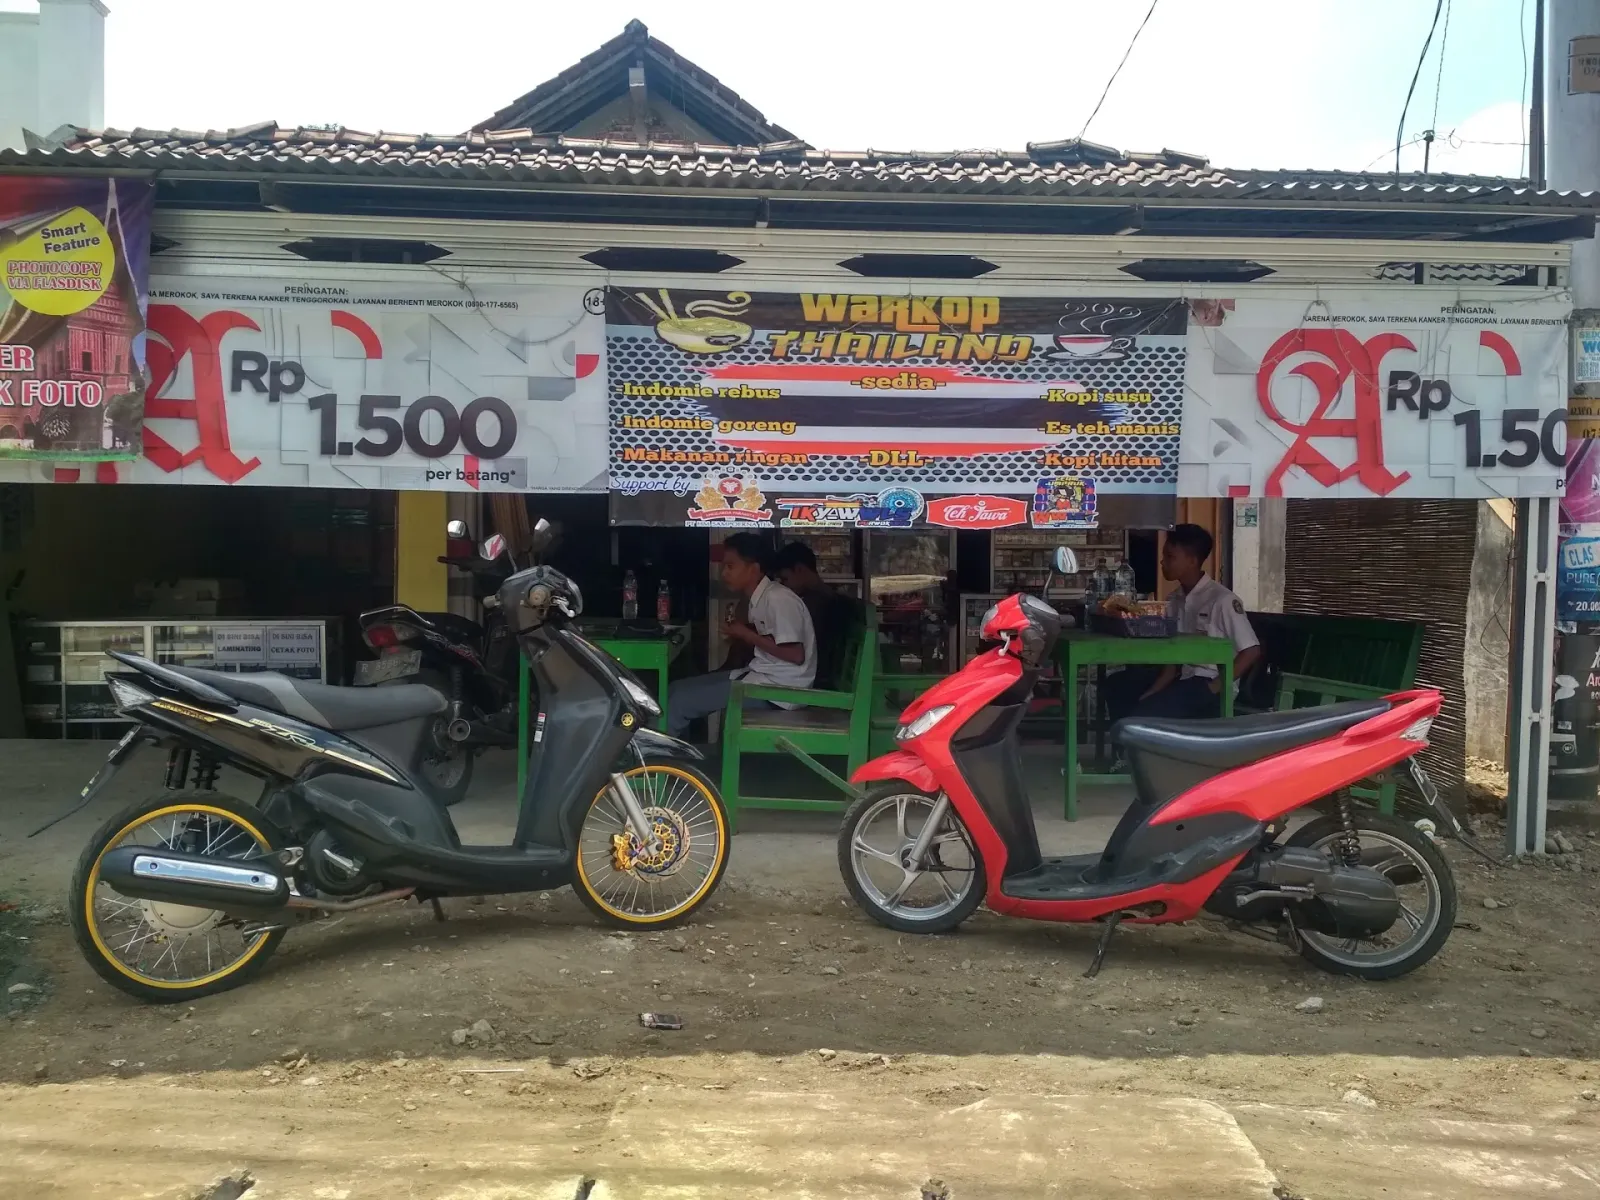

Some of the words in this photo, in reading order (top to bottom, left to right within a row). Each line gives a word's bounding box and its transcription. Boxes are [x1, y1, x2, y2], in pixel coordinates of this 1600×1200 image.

[41, 222, 86, 239] Smart
[44, 236, 101, 254] Feature
[7, 260, 103, 276] PHOTOCOPY
[7, 276, 31, 290] VIA
[33, 277, 103, 292] FLASDISK
[284, 286, 349, 296] PERINGATAN:
[158, 290, 199, 299] MEROKOK,
[201, 292, 220, 300] SAYA
[222, 293, 257, 301] TERKENA
[258, 294, 290, 303] KANKER
[352, 297, 387, 305] LAYANAN
[388, 298, 425, 307] BERHENTI
[427, 299, 464, 308] MEROKOK
[1440, 306, 1497, 315] PERINGATAN:
[1332, 315, 1368, 323] MEROKOK,
[1369, 315, 1386, 323] SAYA
[1387, 315, 1418, 323] TERKENA
[1418, 316, 1446, 324] KANKER
[1500, 317, 1530, 325] LAYANAN
[1531, 318, 1562, 326] BERHENTI
[767, 331, 1034, 361] THAILAND
[231, 350, 306, 403] Rp
[22, 380, 103, 408] FOTO
[717, 384, 781, 399] rebus
[1103, 392, 1152, 403] susu
[1386, 370, 1452, 420] Rp
[308, 393, 518, 460] 1.500
[717, 419, 798, 435] goreng
[1075, 421, 1111, 435] teh
[1115, 421, 1181, 435] manis
[735, 450, 809, 466] ringan
[1099, 452, 1163, 467] hitam
[425, 469, 452, 482] per
[611, 476, 669, 496] Support
[672, 476, 691, 498] by
[943, 504, 970, 522] Teh
[968, 500, 1011, 522] Jawa
[217, 645, 262, 653] LAMINATING
[270, 646, 295, 654] CETAK
[296, 646, 316, 654] FOTO
